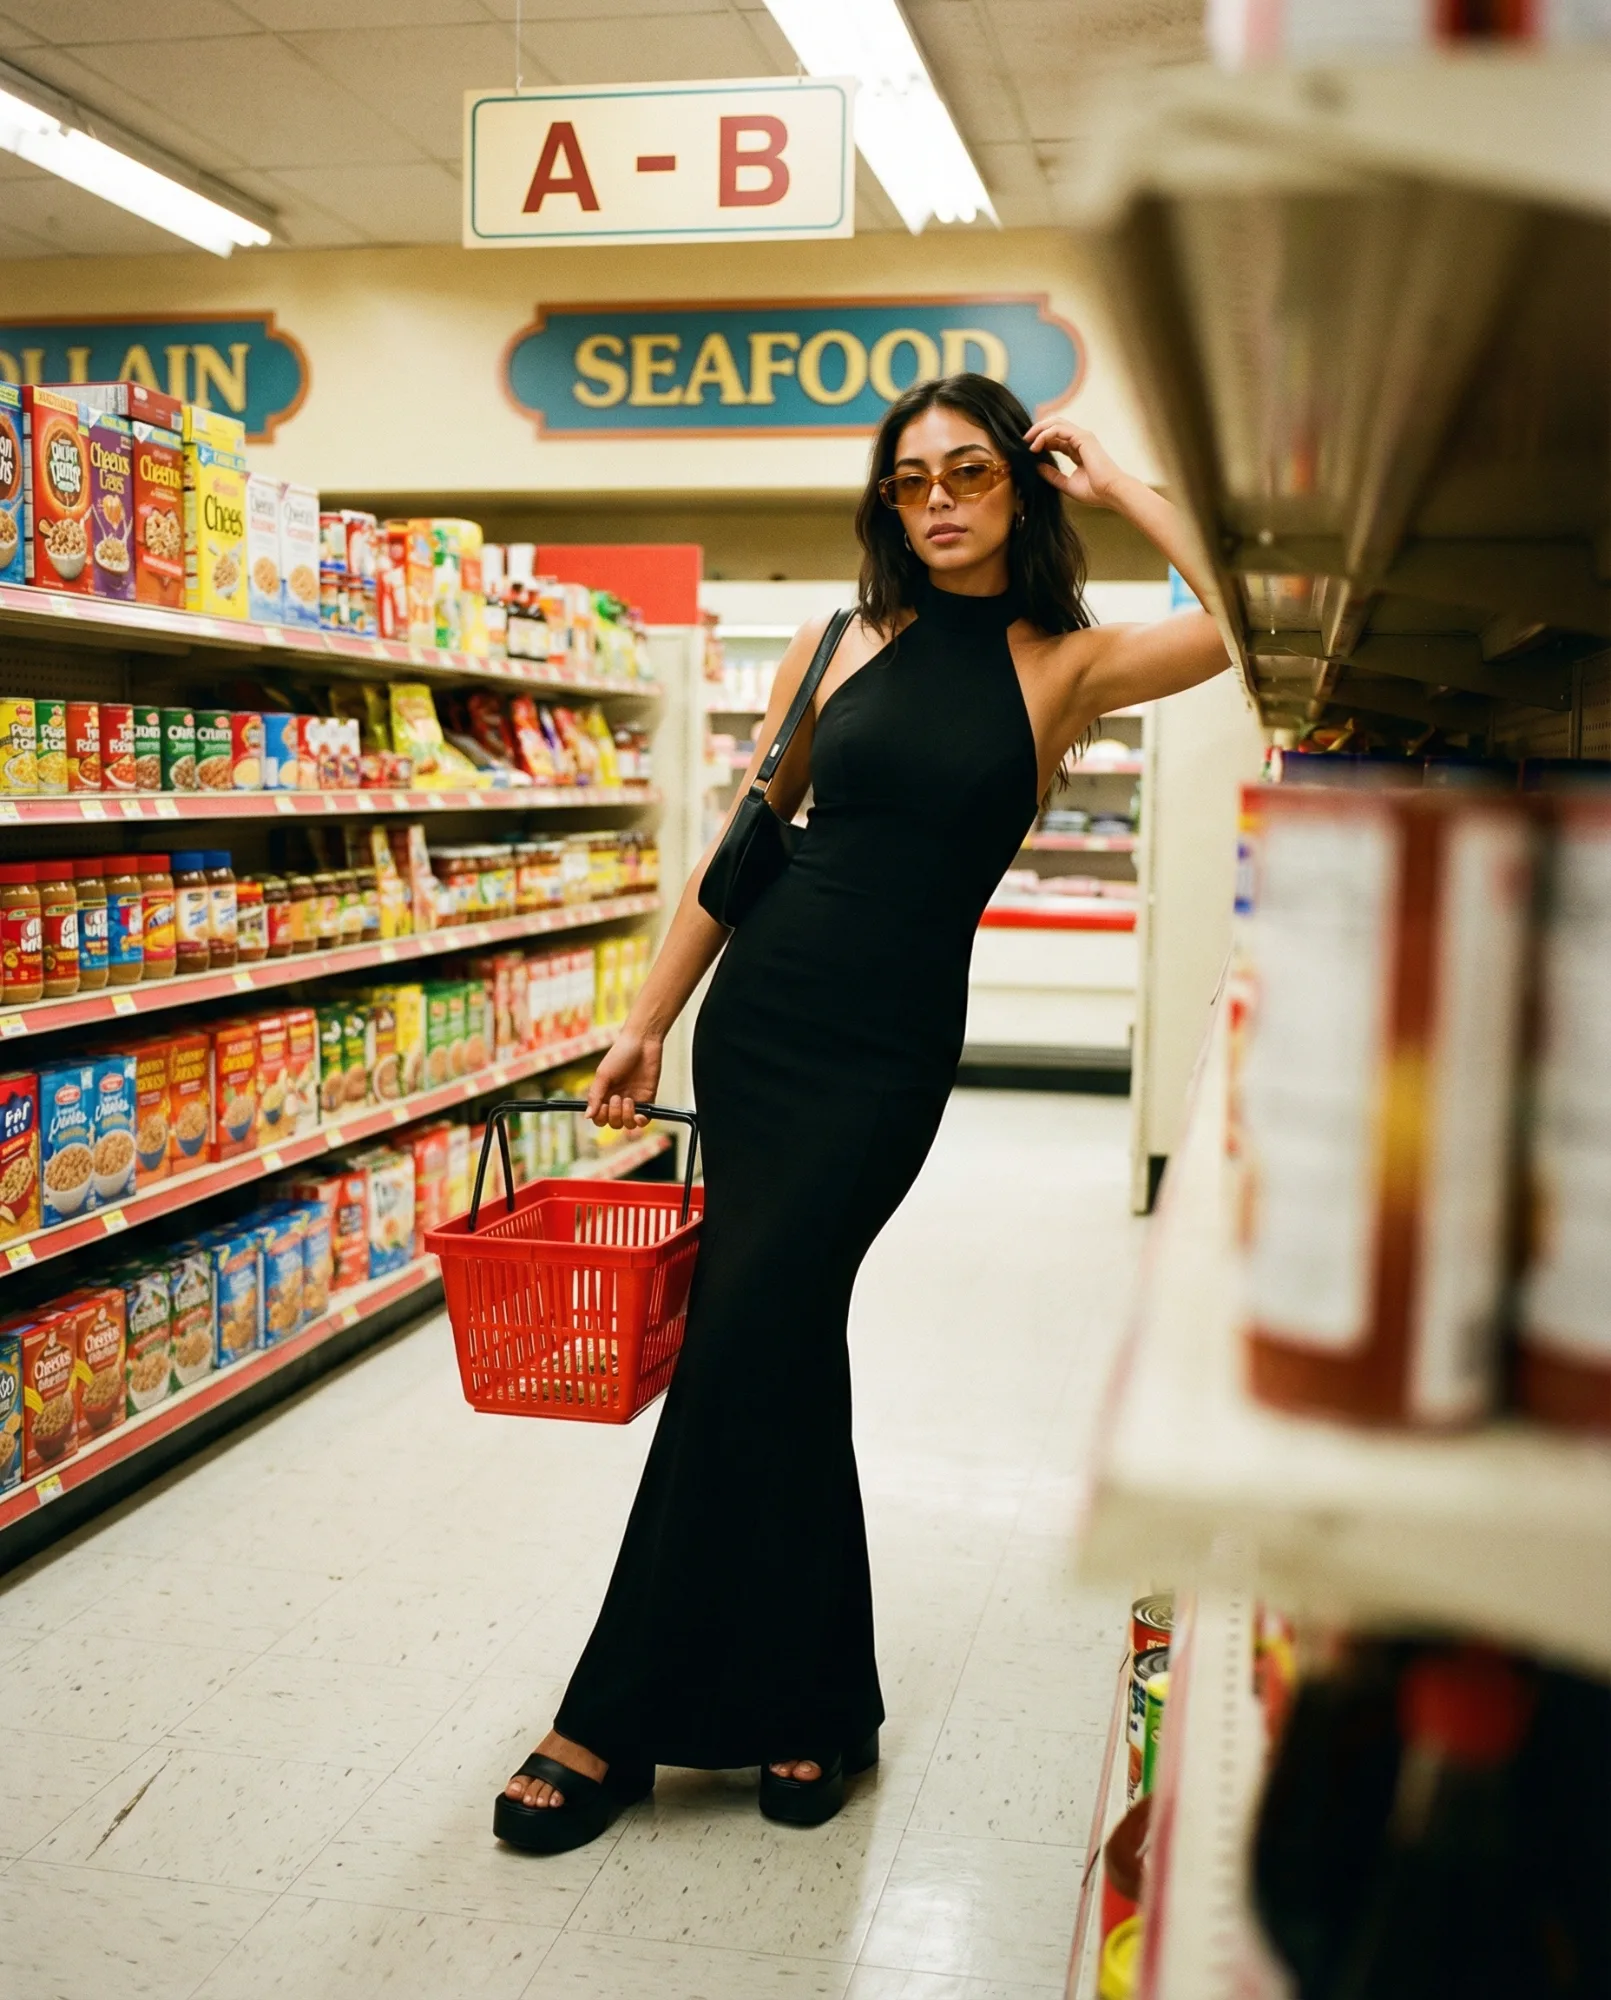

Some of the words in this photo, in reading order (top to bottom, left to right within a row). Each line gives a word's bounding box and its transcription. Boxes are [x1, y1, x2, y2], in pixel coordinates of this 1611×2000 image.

[521, 121, 602, 214] A
[718, 114, 791, 208] B
[572, 328, 1009, 409] SEAFOOD
